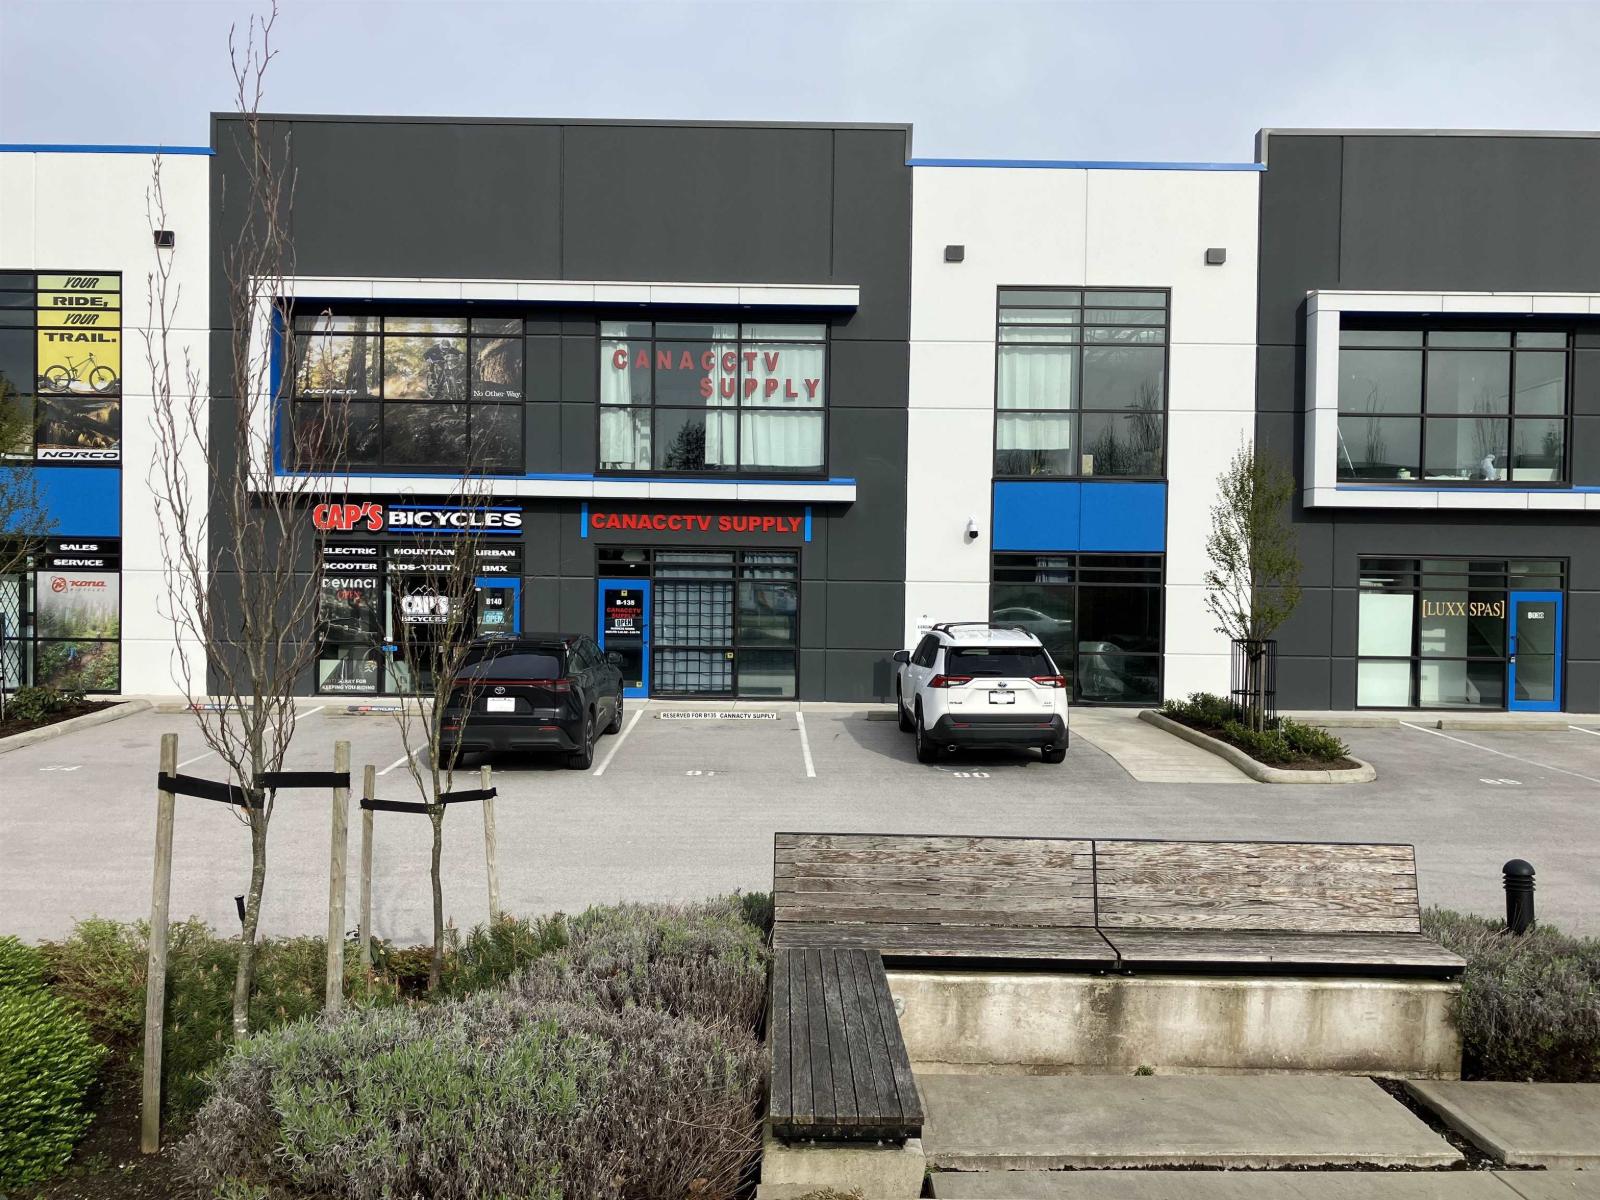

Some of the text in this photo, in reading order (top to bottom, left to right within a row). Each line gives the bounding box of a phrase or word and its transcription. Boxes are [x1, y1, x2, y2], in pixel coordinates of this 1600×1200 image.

[63, 277, 99, 289] YOUR
[53, 296, 109, 307] RIDE,
[63, 313, 100, 325] YOUR
[44, 332, 117, 343] TRAIL.
[612, 349, 780, 372] CANACCTV
[484, 390, 505, 398] Other
[699, 378, 821, 399] SUPPLY
[42, 451, 118, 459] NORCO
[312, 502, 522, 531] CAP'S BICYCLES
[591, 512, 802, 533] CANACCTV SUPPLY
[323, 547, 377, 555] ELECTRIC
[475, 549, 516, 557] URBAN
[53, 559, 104, 567] SERVICE
[322, 562, 377, 570] SCOOTER
[616, 618, 632, 627] OPEN
